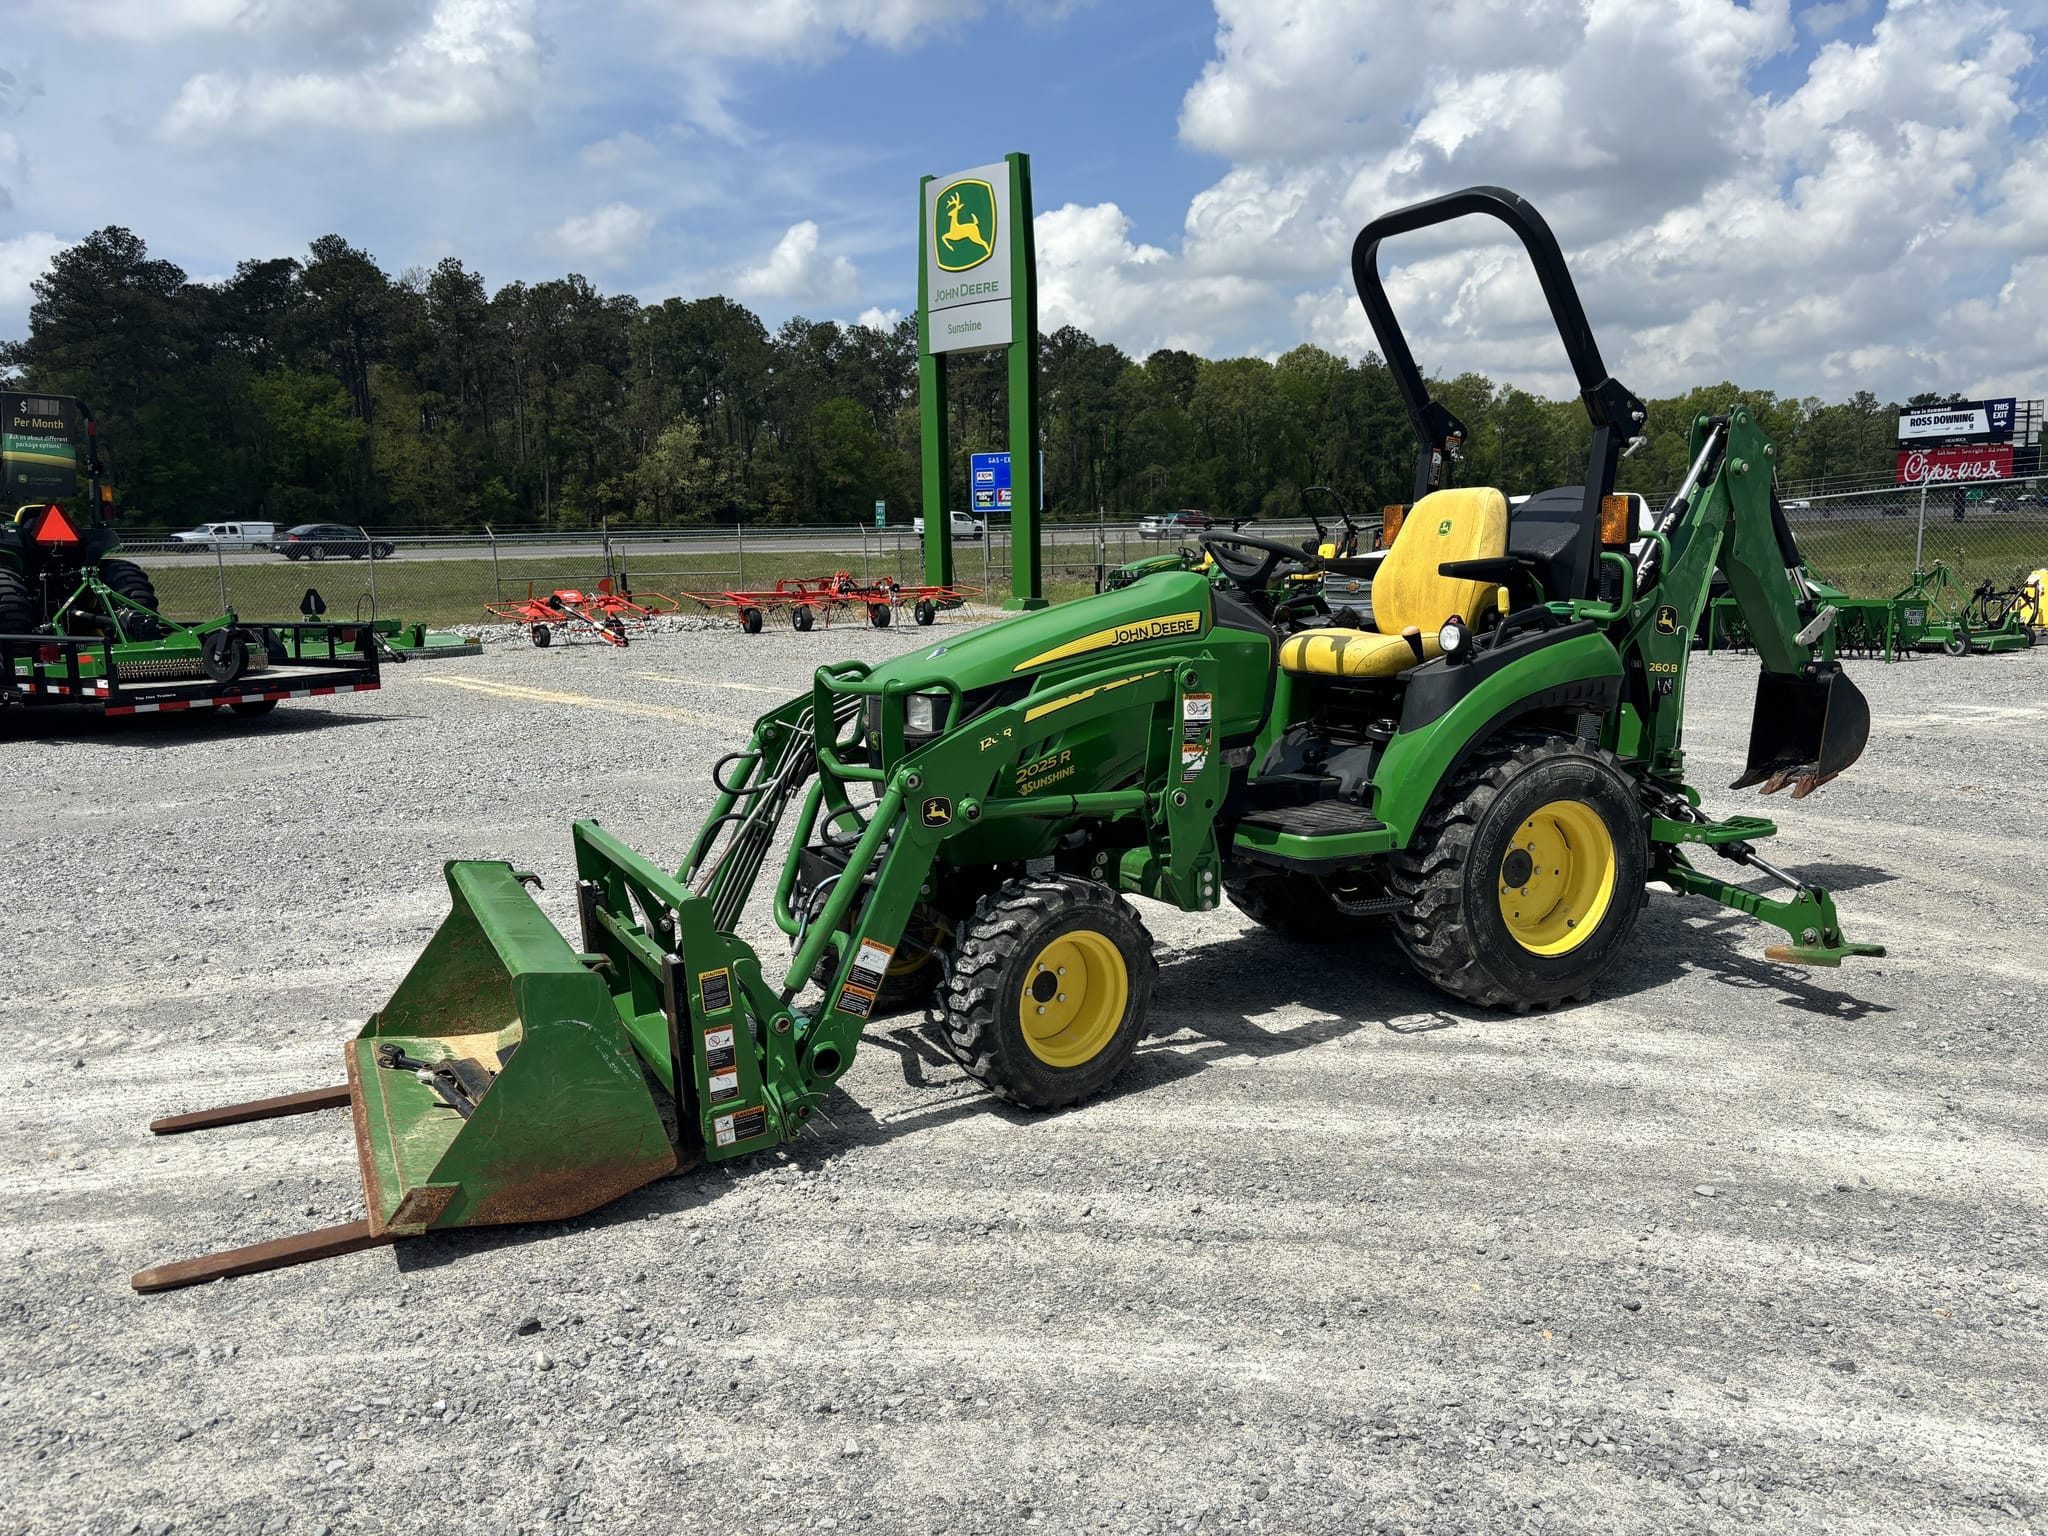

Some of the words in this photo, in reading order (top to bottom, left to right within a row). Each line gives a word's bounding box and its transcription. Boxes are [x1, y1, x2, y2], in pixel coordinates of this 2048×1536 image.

[934, 286, 959, 302] JOHN
[960, 281, 999, 297] DEERE
[947, 320, 982, 335] Sunshine
[20, 400, 27, 413] $
[1993, 403, 2009, 411] THIS
[1910, 416, 1932, 427] ROSS
[1933, 413, 1974, 425] DOWNING
[1993, 411, 2008, 420] EXIT
[14, 417, 29, 427] Per
[32, 417, 64, 429] Month
[16, 441, 38, 449] package
[1904, 453, 2001, 482] Chick-fil-A
[1111, 627, 1149, 644] JOHN
[1151, 619, 1194, 636] DEERE
[1649, 662, 1670, 672] 260
[1671, 664, 1678, 673] B
[1016, 755, 1057, 784] 2025
[1060, 750, 1071, 764] R
[1026, 765, 1075, 793] SUNSHINE
